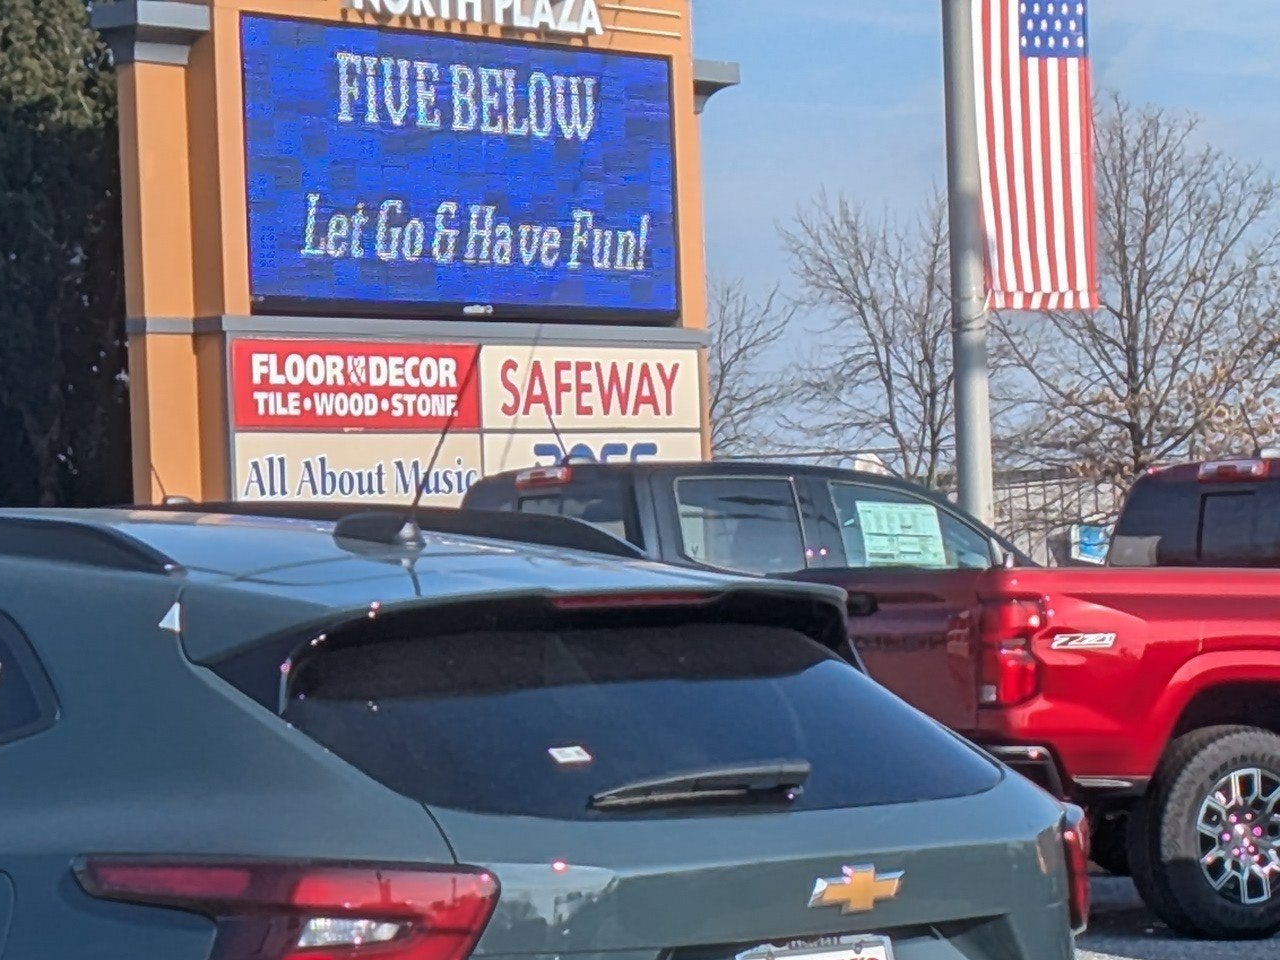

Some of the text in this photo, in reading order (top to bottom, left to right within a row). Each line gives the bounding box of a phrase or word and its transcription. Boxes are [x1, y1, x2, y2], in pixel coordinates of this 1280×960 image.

[353, 0, 604, 35] RTH PLAZA
[337, 52, 598, 140] FIVE BELOW
[300, 193, 651, 271] Let Go & Have Fun!
[251, 353, 345, 386] FLOOR
[369, 356, 457, 387] DECOR
[500, 359, 680, 416] SAFEWAY
[253, 391, 458, 417] TILE WOOD STONE
[244, 455, 477, 497] All About Music
